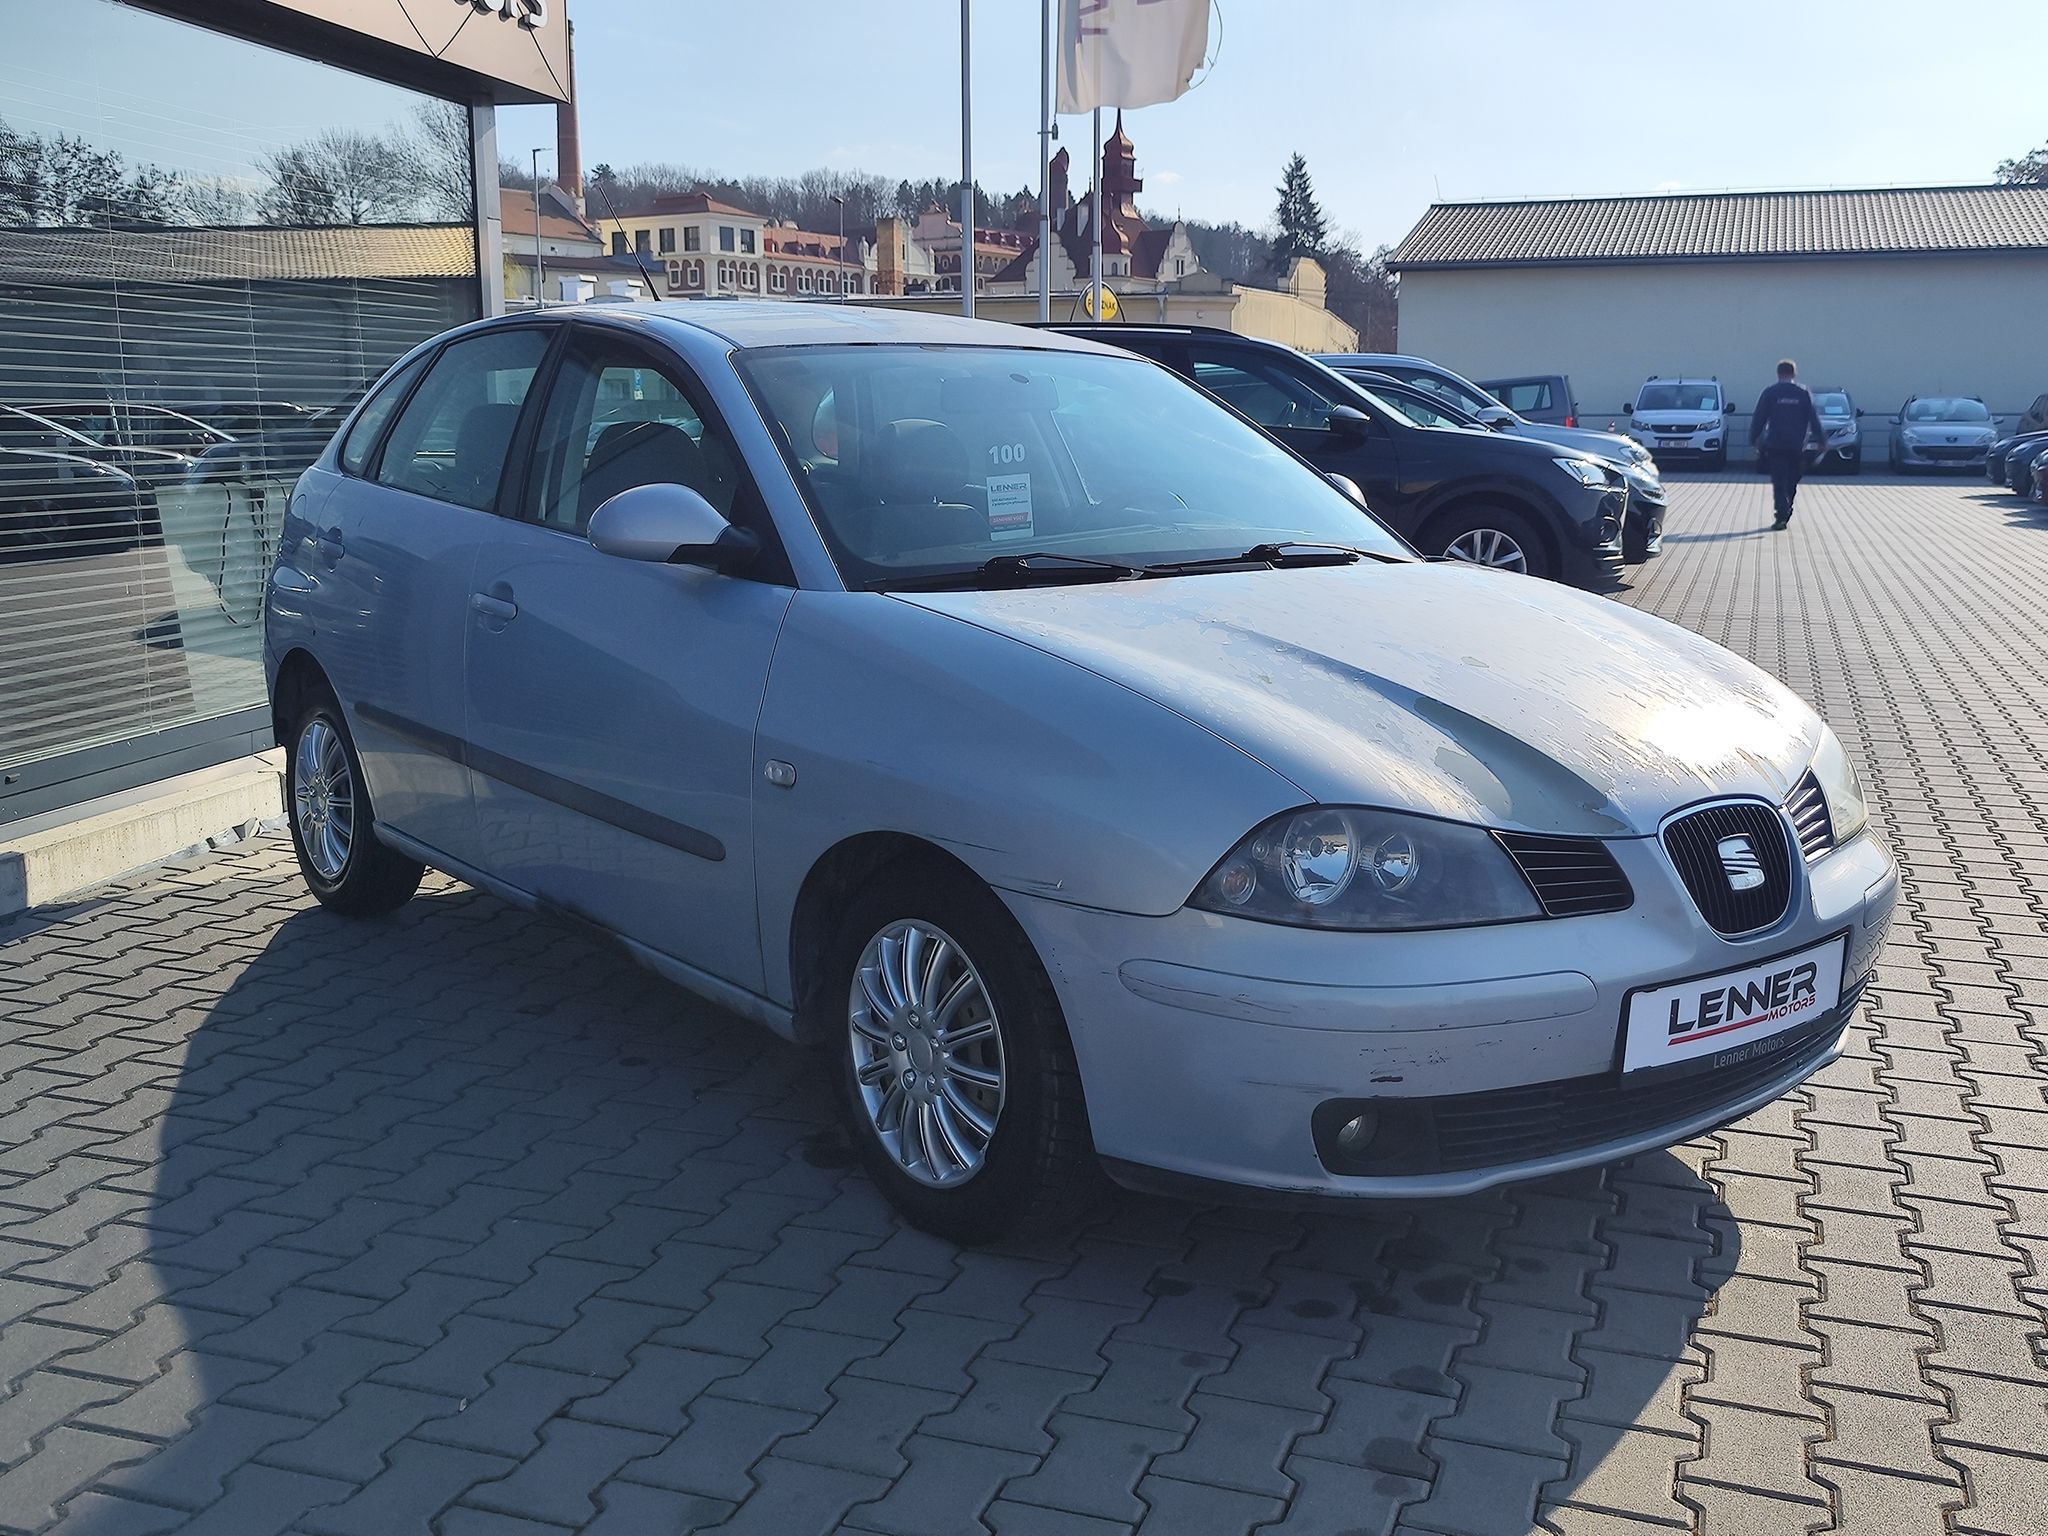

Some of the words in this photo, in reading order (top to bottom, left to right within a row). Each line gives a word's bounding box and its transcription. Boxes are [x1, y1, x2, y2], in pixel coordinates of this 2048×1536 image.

[988, 443, 1025, 464] 100
[990, 483, 1027, 492] LENNER
[1668, 961, 1818, 1036] LENNER
[1767, 993, 1817, 1022] MOTORS
[1713, 1047, 1750, 1069] Lenner
[1752, 1034, 1786, 1057] Motors
